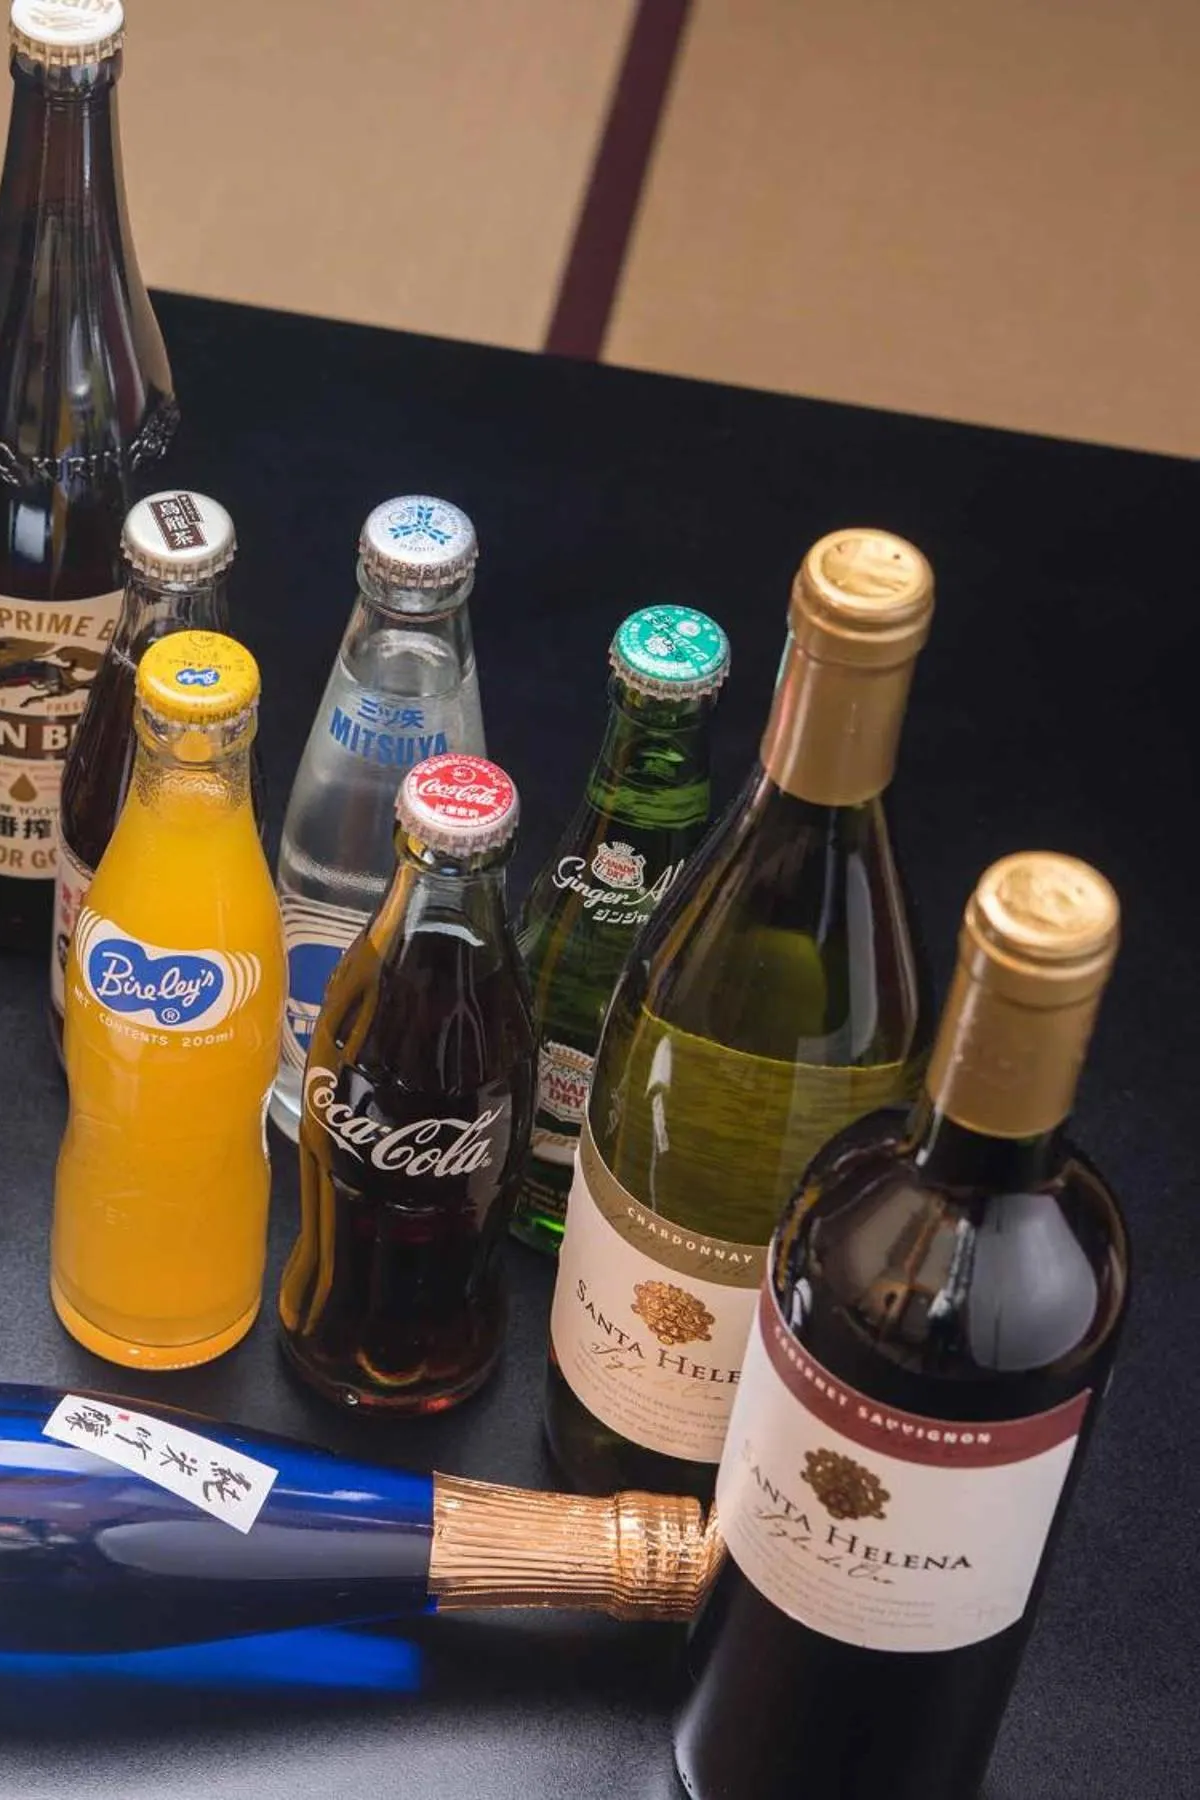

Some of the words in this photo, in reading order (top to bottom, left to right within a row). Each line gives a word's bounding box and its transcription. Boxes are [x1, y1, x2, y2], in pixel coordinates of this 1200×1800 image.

[329, 705, 449, 768] MITSUYA
[551, 855, 629, 908] Ginger
[97, 951, 216, 1008] Bireley's
[99, 1012, 169, 1047] CONTENTS
[303, 1066, 504, 1178] Coca-Cola
[626, 1206, 754, 1265] CHARDONNAY
[575, 1279, 647, 1360] SANTA
[655, 1348, 743, 1385] HELE
[857, 1405, 992, 1446] SAUVIGNON
[748, 1455, 813, 1535] ANTA
[825, 1523, 973, 1571] HELENA
